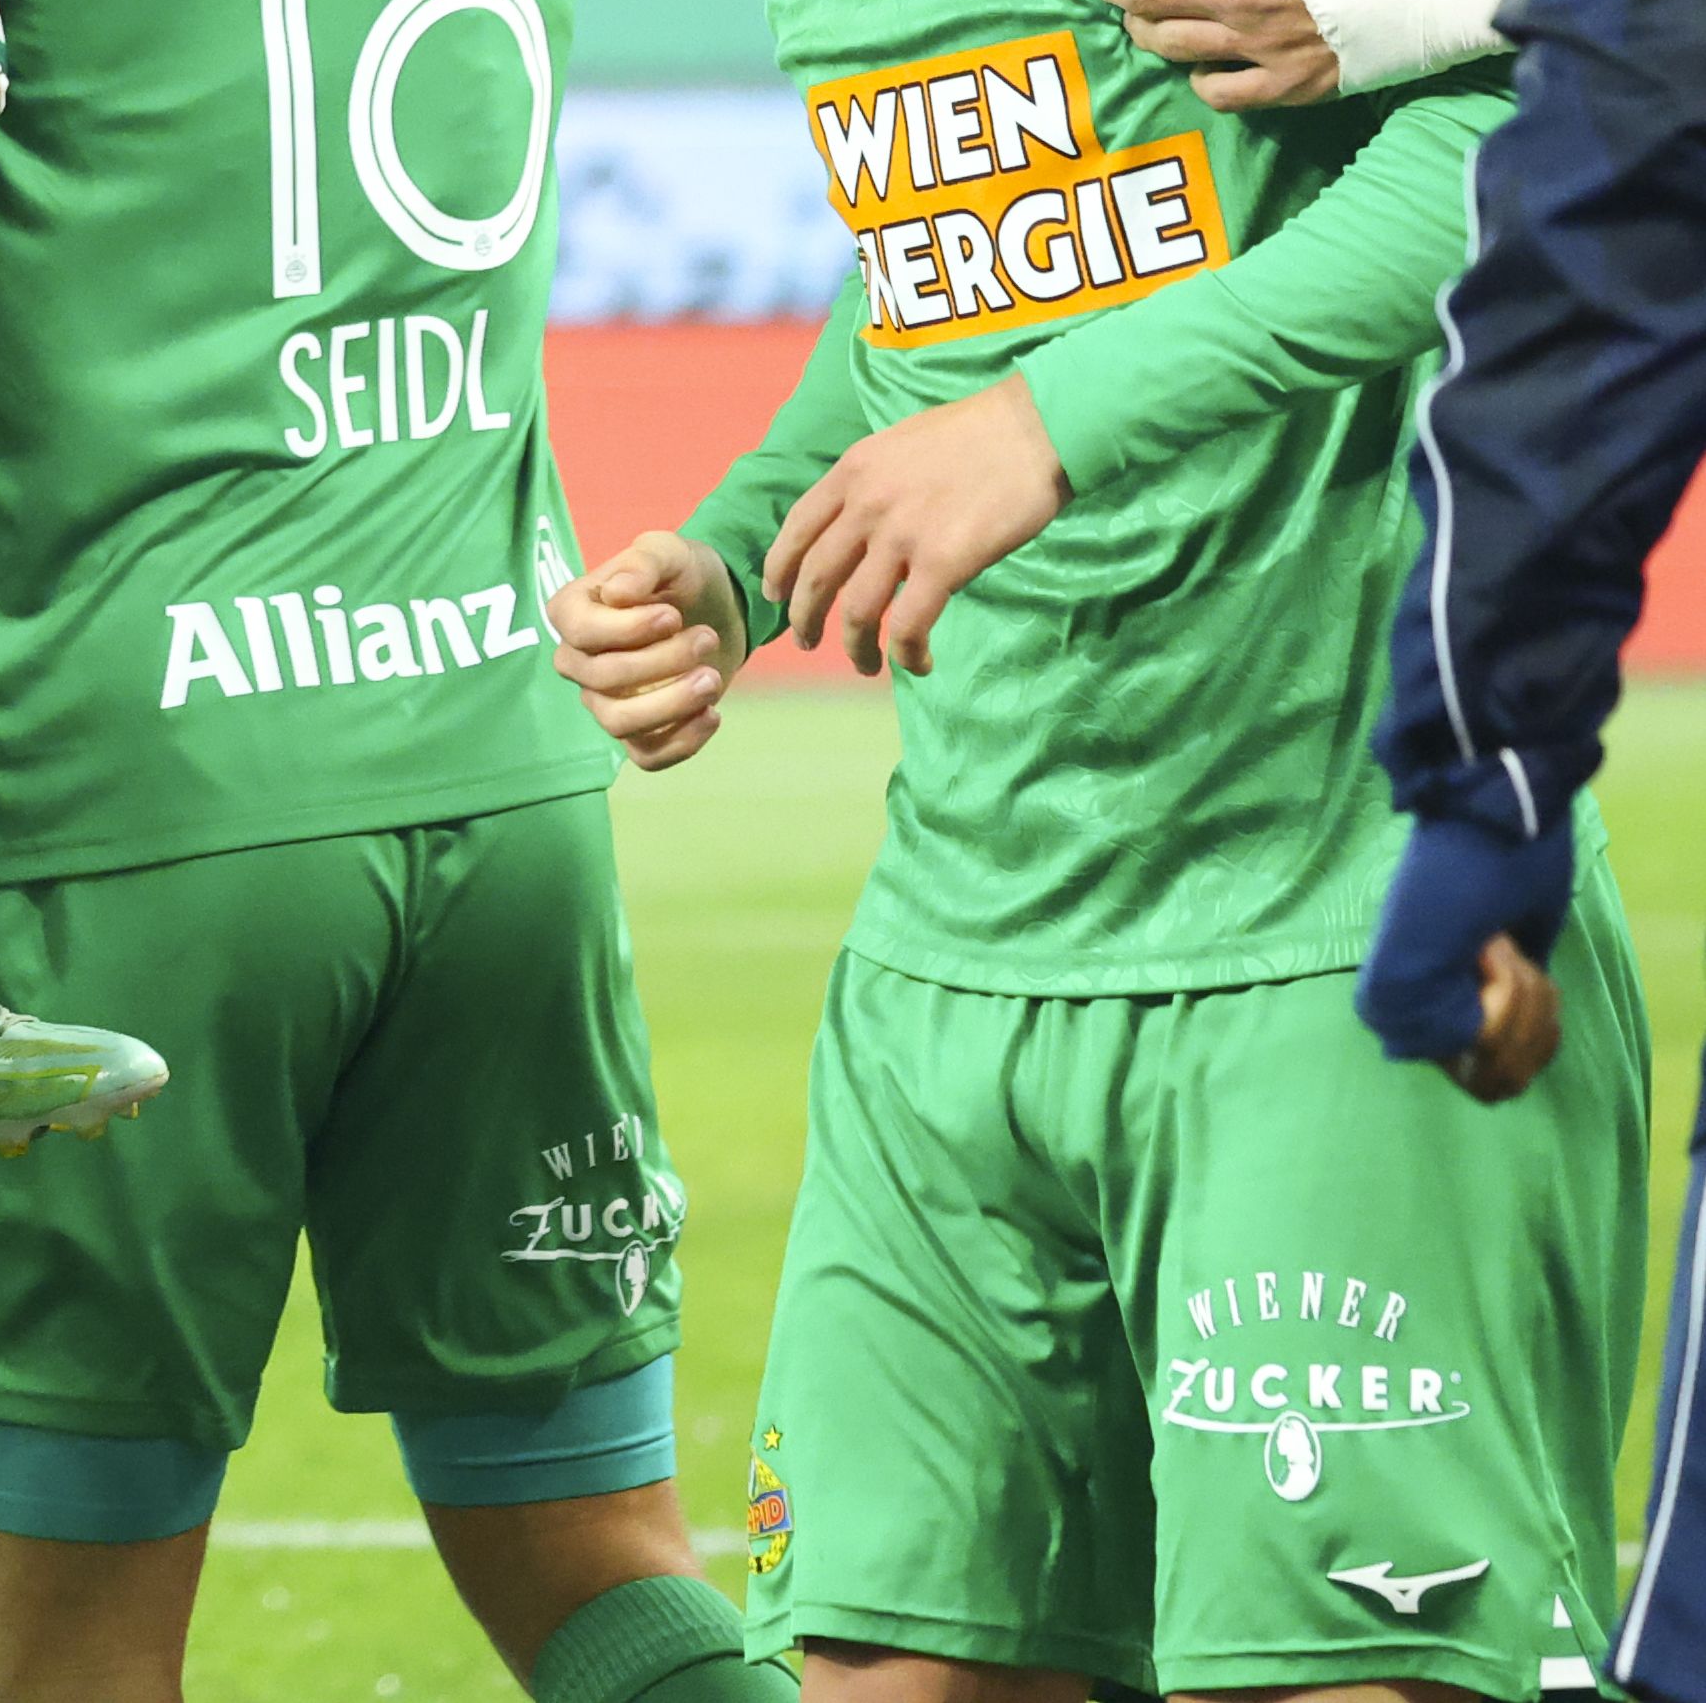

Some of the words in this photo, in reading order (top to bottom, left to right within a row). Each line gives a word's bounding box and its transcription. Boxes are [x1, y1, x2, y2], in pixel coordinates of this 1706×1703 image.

[816, 54, 1082, 208] WIEN
[858, 156, 1208, 330] NERGIE
[279, 309, 511, 459] SEIDL
[160, 583, 540, 710] Allianz
[1187, 1271, 1407, 1343] WIENER
[1161, 1357, 1445, 1433] ZUCKER
